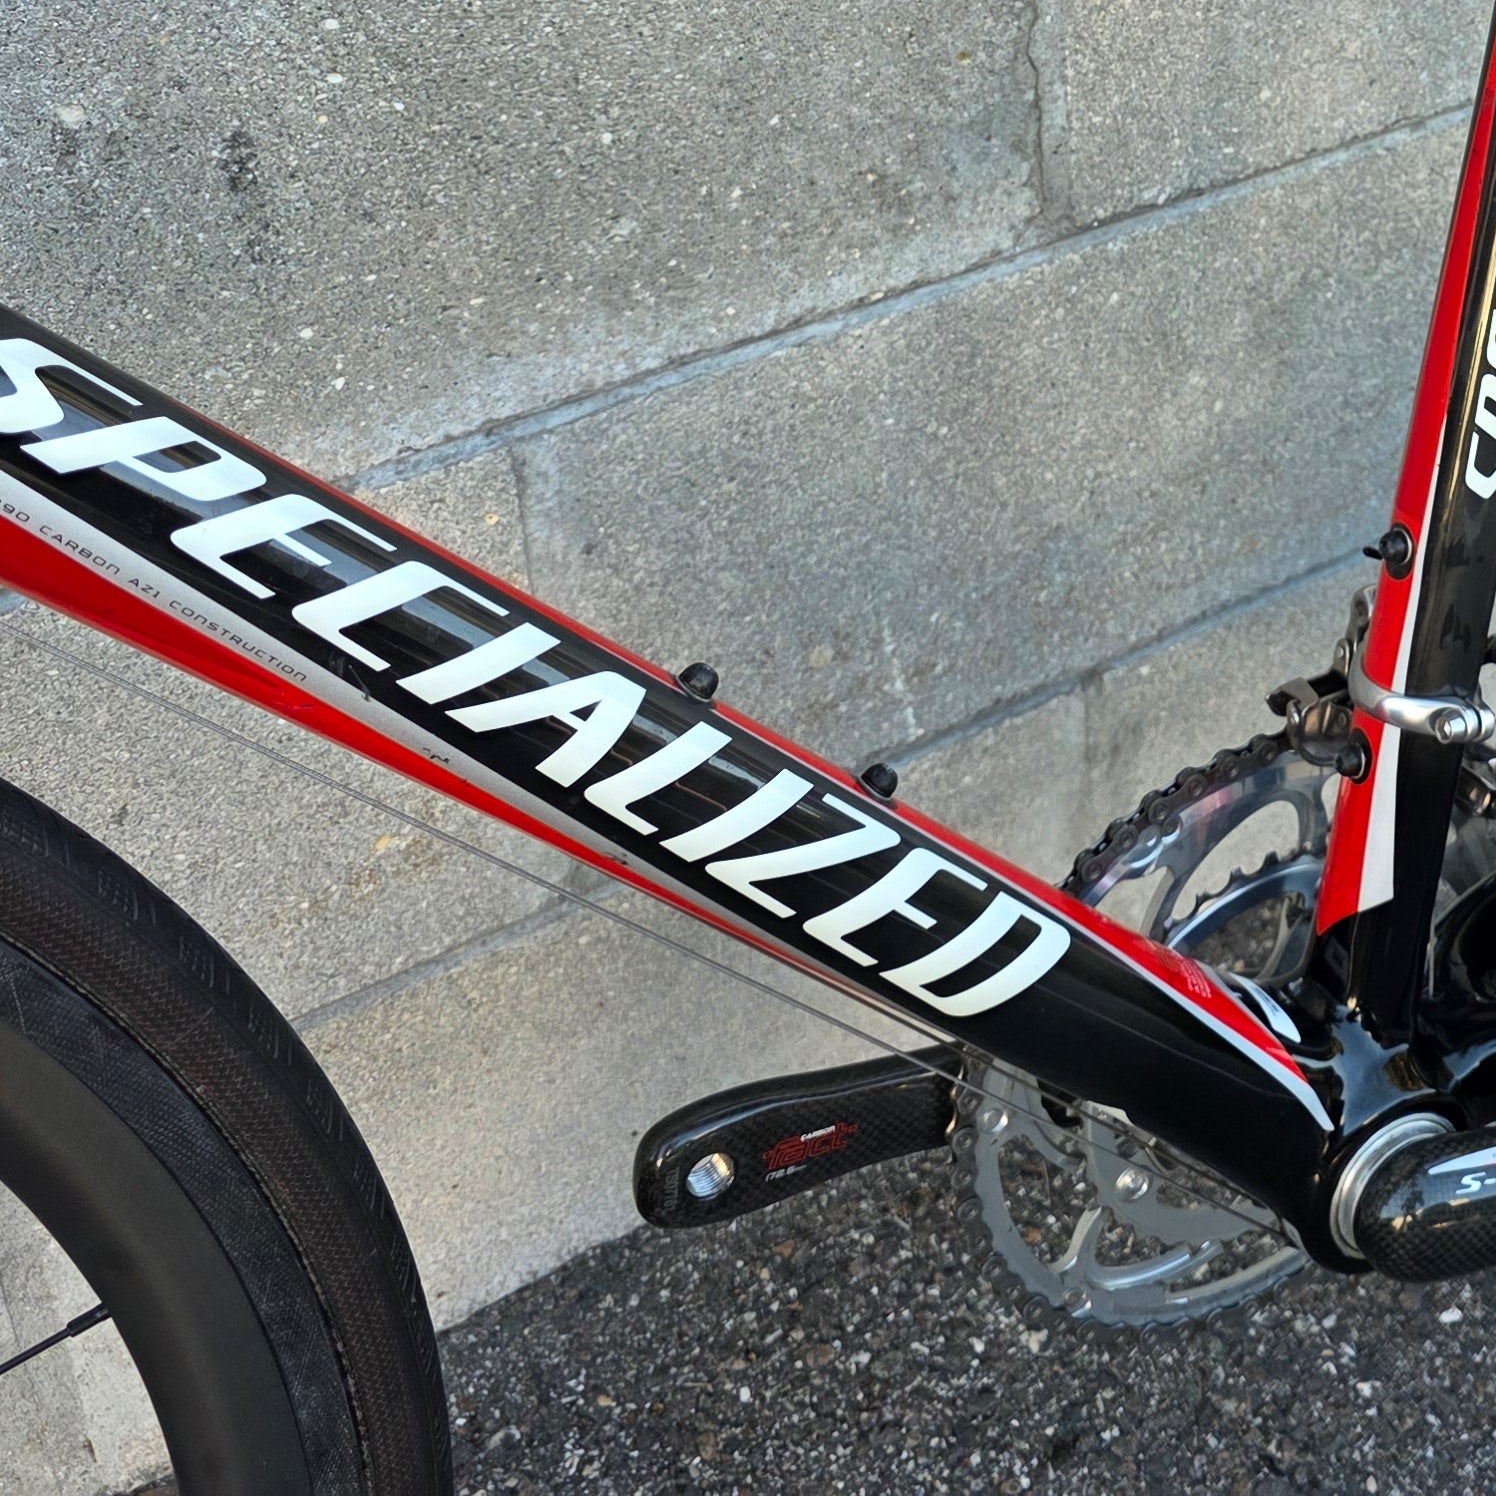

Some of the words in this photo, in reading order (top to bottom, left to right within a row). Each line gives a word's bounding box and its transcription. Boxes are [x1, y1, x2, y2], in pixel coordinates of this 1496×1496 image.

[0, 338, 1071, 1017] SPECIALIZED
[39, 525, 120, 575] CARBON
[168, 600, 307, 682] CONSTRUCTION
